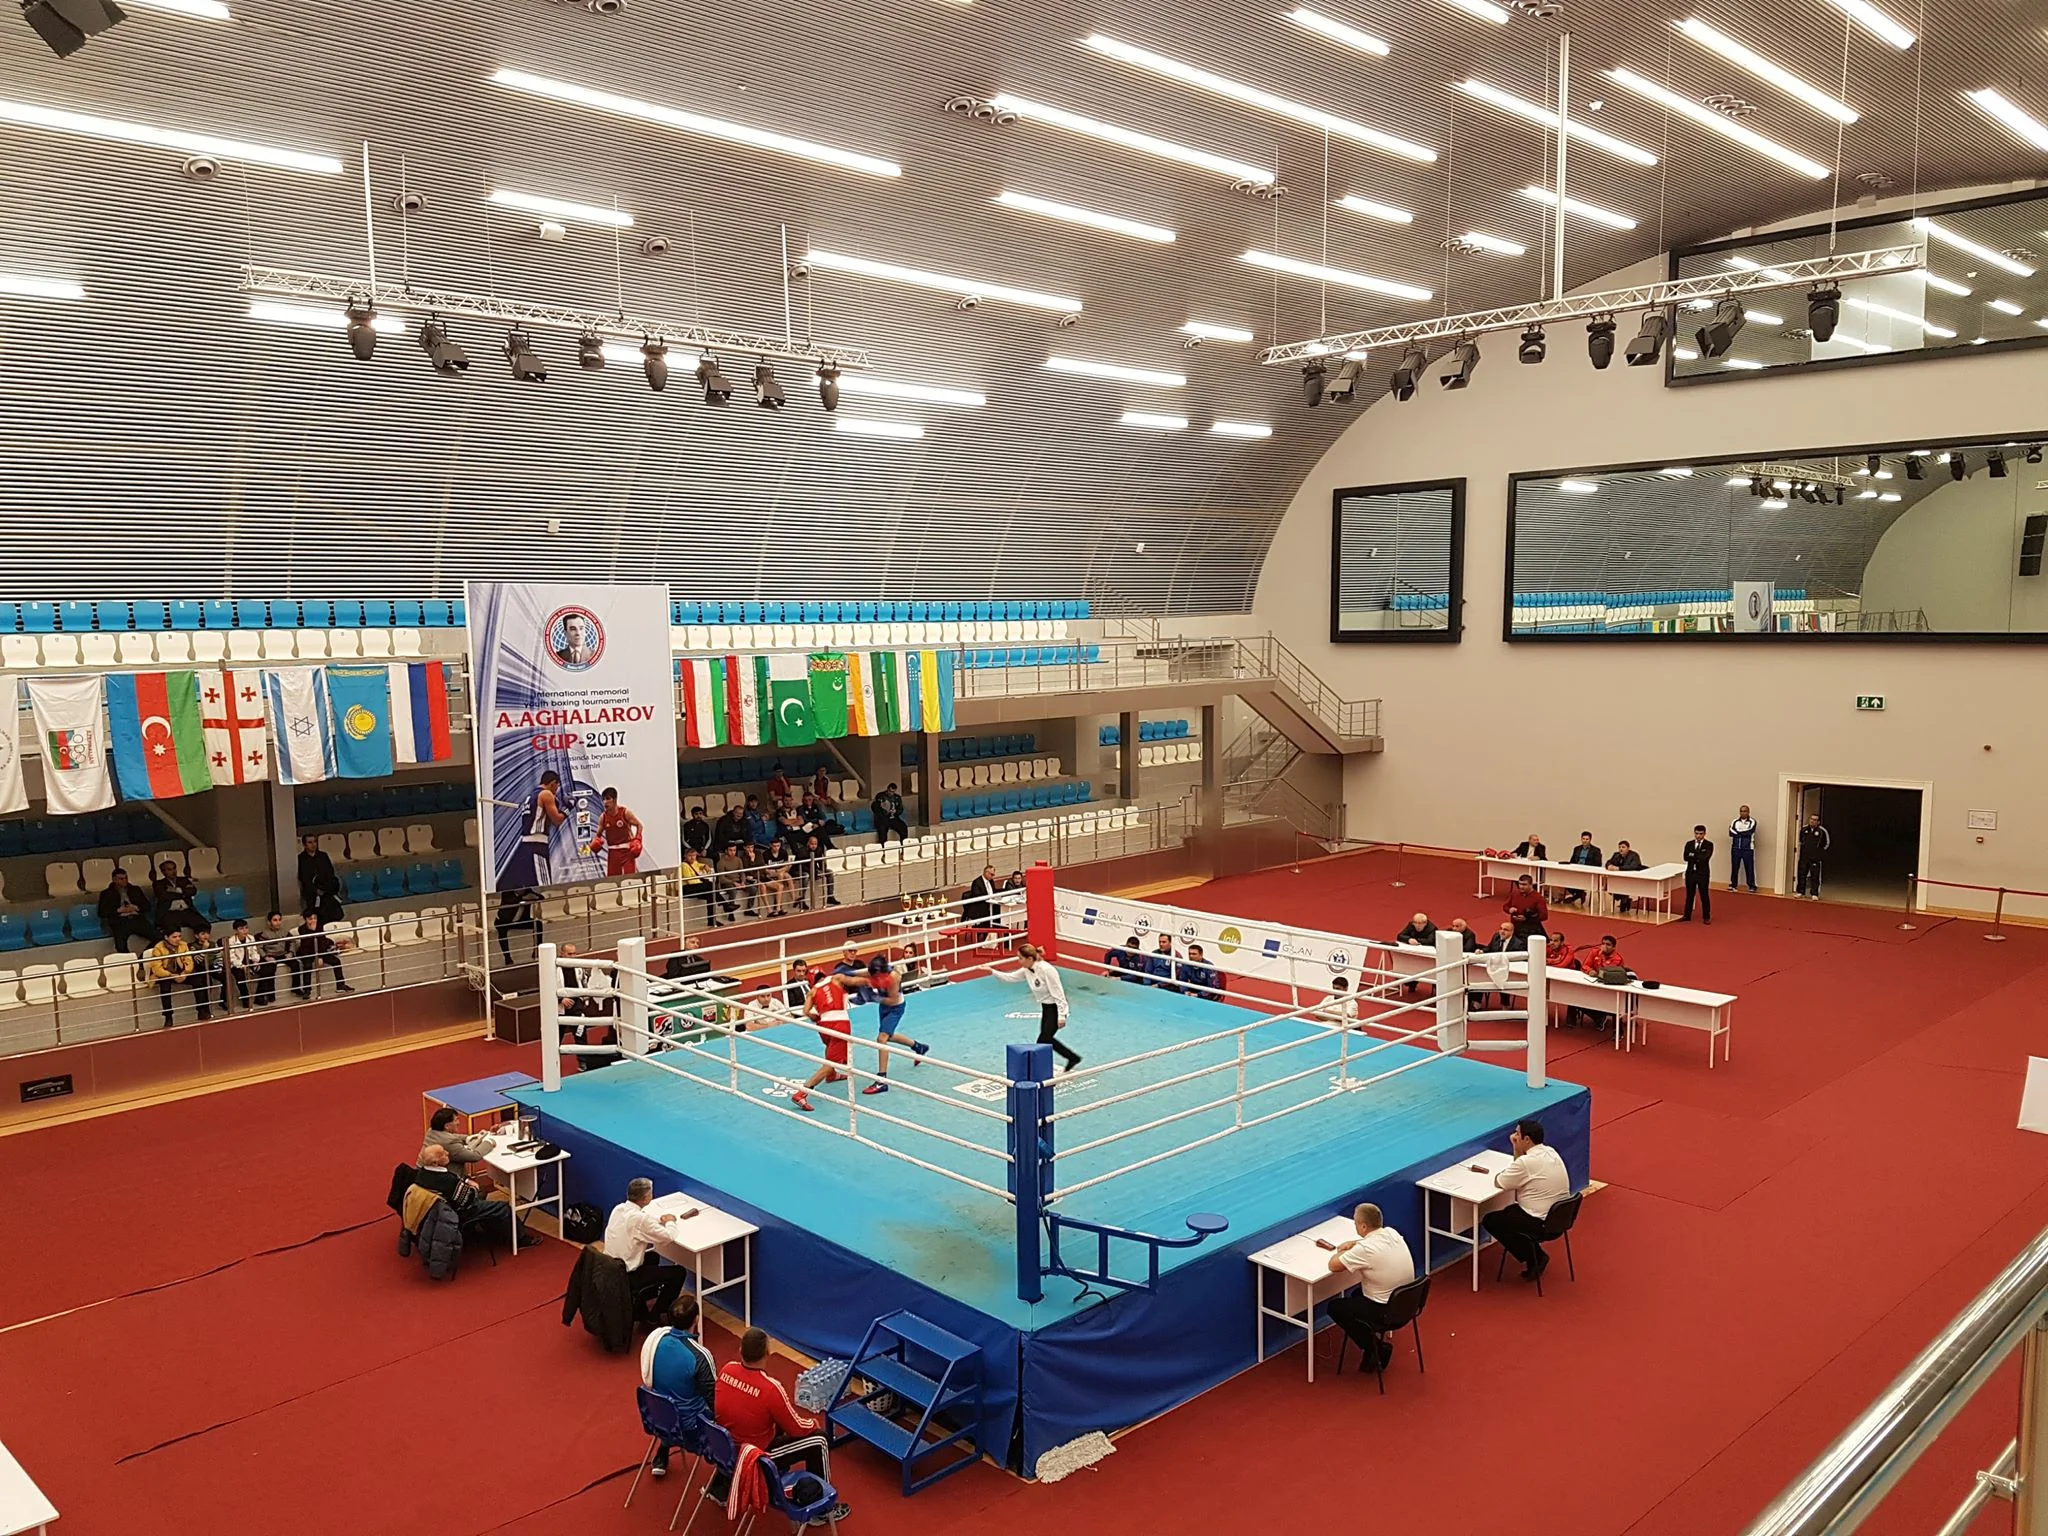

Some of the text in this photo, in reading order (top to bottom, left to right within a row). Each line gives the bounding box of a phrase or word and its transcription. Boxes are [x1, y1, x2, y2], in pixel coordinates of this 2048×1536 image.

[551, 699, 580, 707] boxing
[582, 697, 630, 706] tournament
[590, 688, 629, 696] memorial
[496, 706, 655, 728] A.AGHALAROV
[531, 731, 626, 752] CUP-2017
[720, 1372, 761, 1398] AZERBAIJAN
